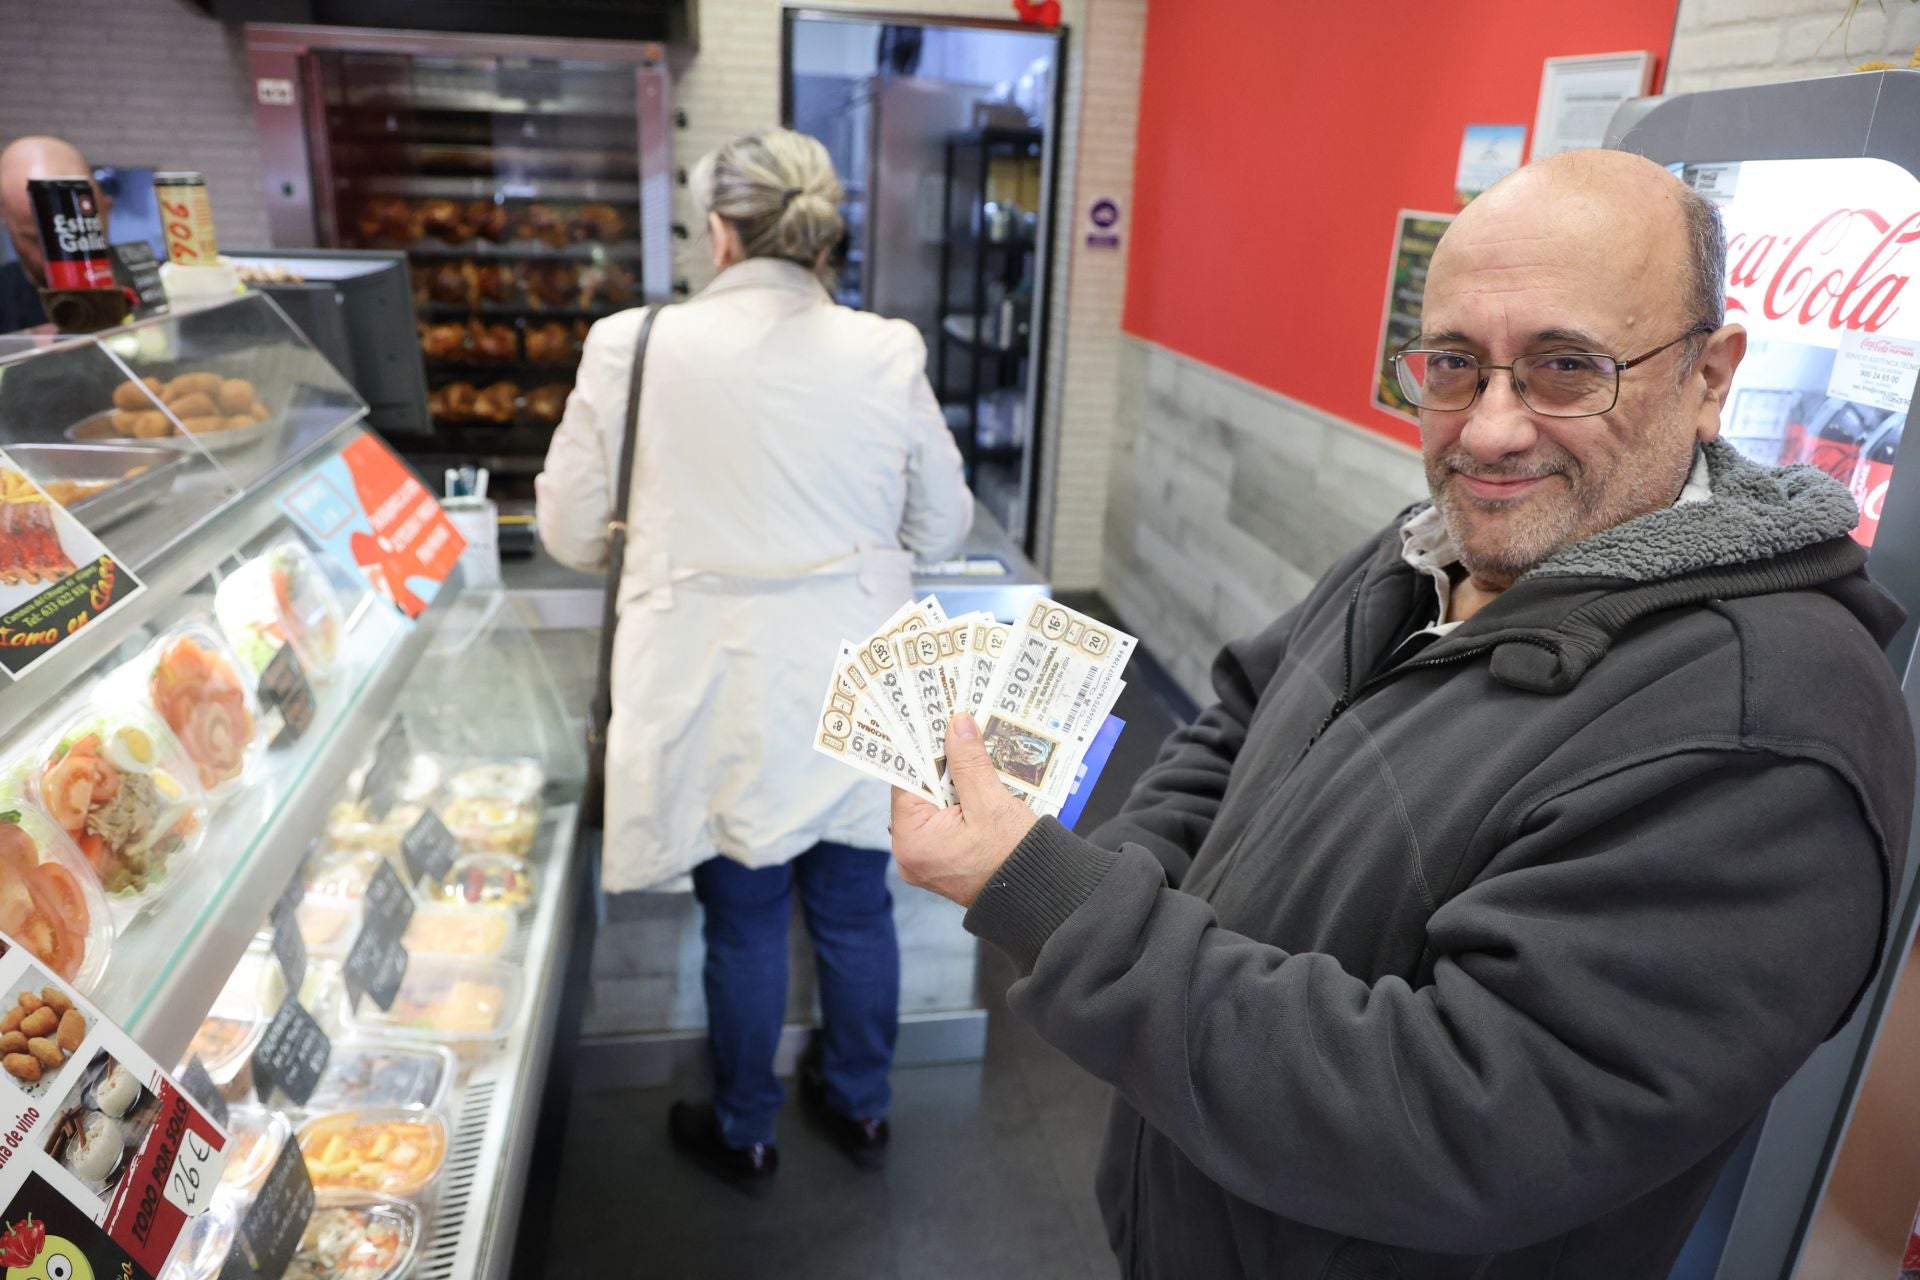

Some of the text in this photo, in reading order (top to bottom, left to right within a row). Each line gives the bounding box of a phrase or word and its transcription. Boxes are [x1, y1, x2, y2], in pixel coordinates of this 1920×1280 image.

[1088, 634, 1101, 649] 20
[999, 636, 1045, 713] 59071
[1035, 644, 1058, 685] NACIONAL
[1038, 660, 1060, 697] NAVIDAD
[1060, 655, 1071, 670] 2024
[4, 1130, 23, 1148] de
[16, 1107, 40, 1133] vino
[131, 1096, 188, 1242] TODO POR SOLO
